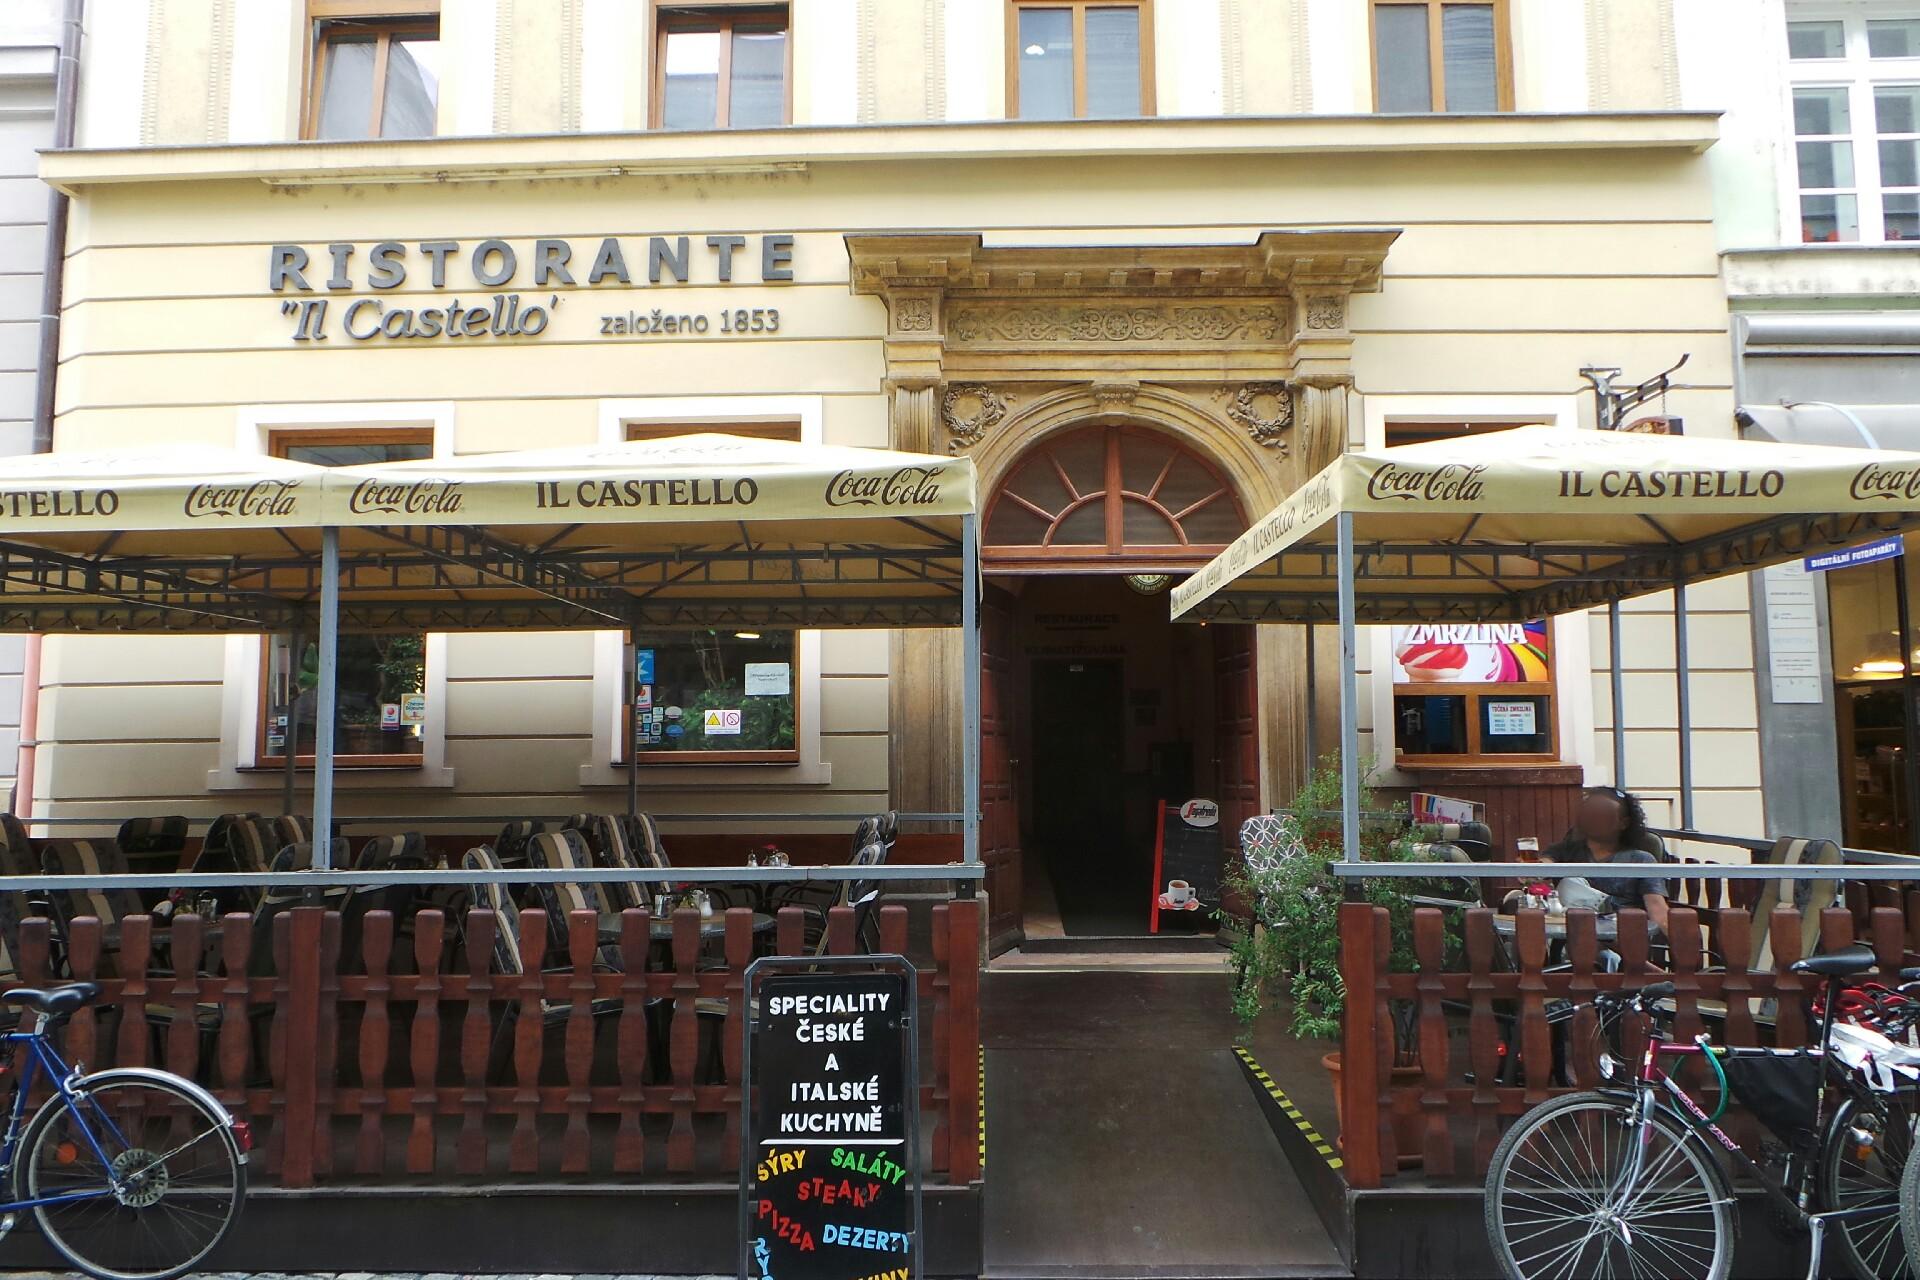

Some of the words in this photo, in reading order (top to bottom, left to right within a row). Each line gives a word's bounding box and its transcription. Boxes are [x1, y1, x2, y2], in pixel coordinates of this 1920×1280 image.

[269, 235, 794, 291] RISTORANTE
[600, 308, 709, 334] založeno
[720, 308, 780, 333] 1853
[350, 477, 465, 515] Coca-Cola
[536, 480, 570, 508] IL
[577, 477, 758, 508] CASTELLO
[825, 466, 945, 507] Coca-Cola
[1367, 462, 1488, 501] Coca-Cola
[1558, 470, 1594, 498] IL
[1600, 469, 1785, 498] CASTELLO
[0, 489, 119, 517] TELLO
[184, 479, 303, 518] Coca-Cola
[1260, 506, 1296, 552] CASTELLO
[1811, 552, 1850, 567] DIGITÁLNÍ
[1852, 542, 1897, 561] FOTOAPARÁTY
[769, 993, 890, 1016] SPECIALITY
[796, 1016, 864, 1043] ČESKÉ
[824, 1053, 840, 1071] A
[791, 1074, 879, 1102] ITALSKÉ
[780, 1105, 882, 1132] KUCHYNĚ
[757, 1148, 806, 1182] SÝRY
[831, 1147, 907, 1186] SALÁTY
[758, 1199, 816, 1251] PIZZA
[822, 1223, 909, 1254] DEZERTY
